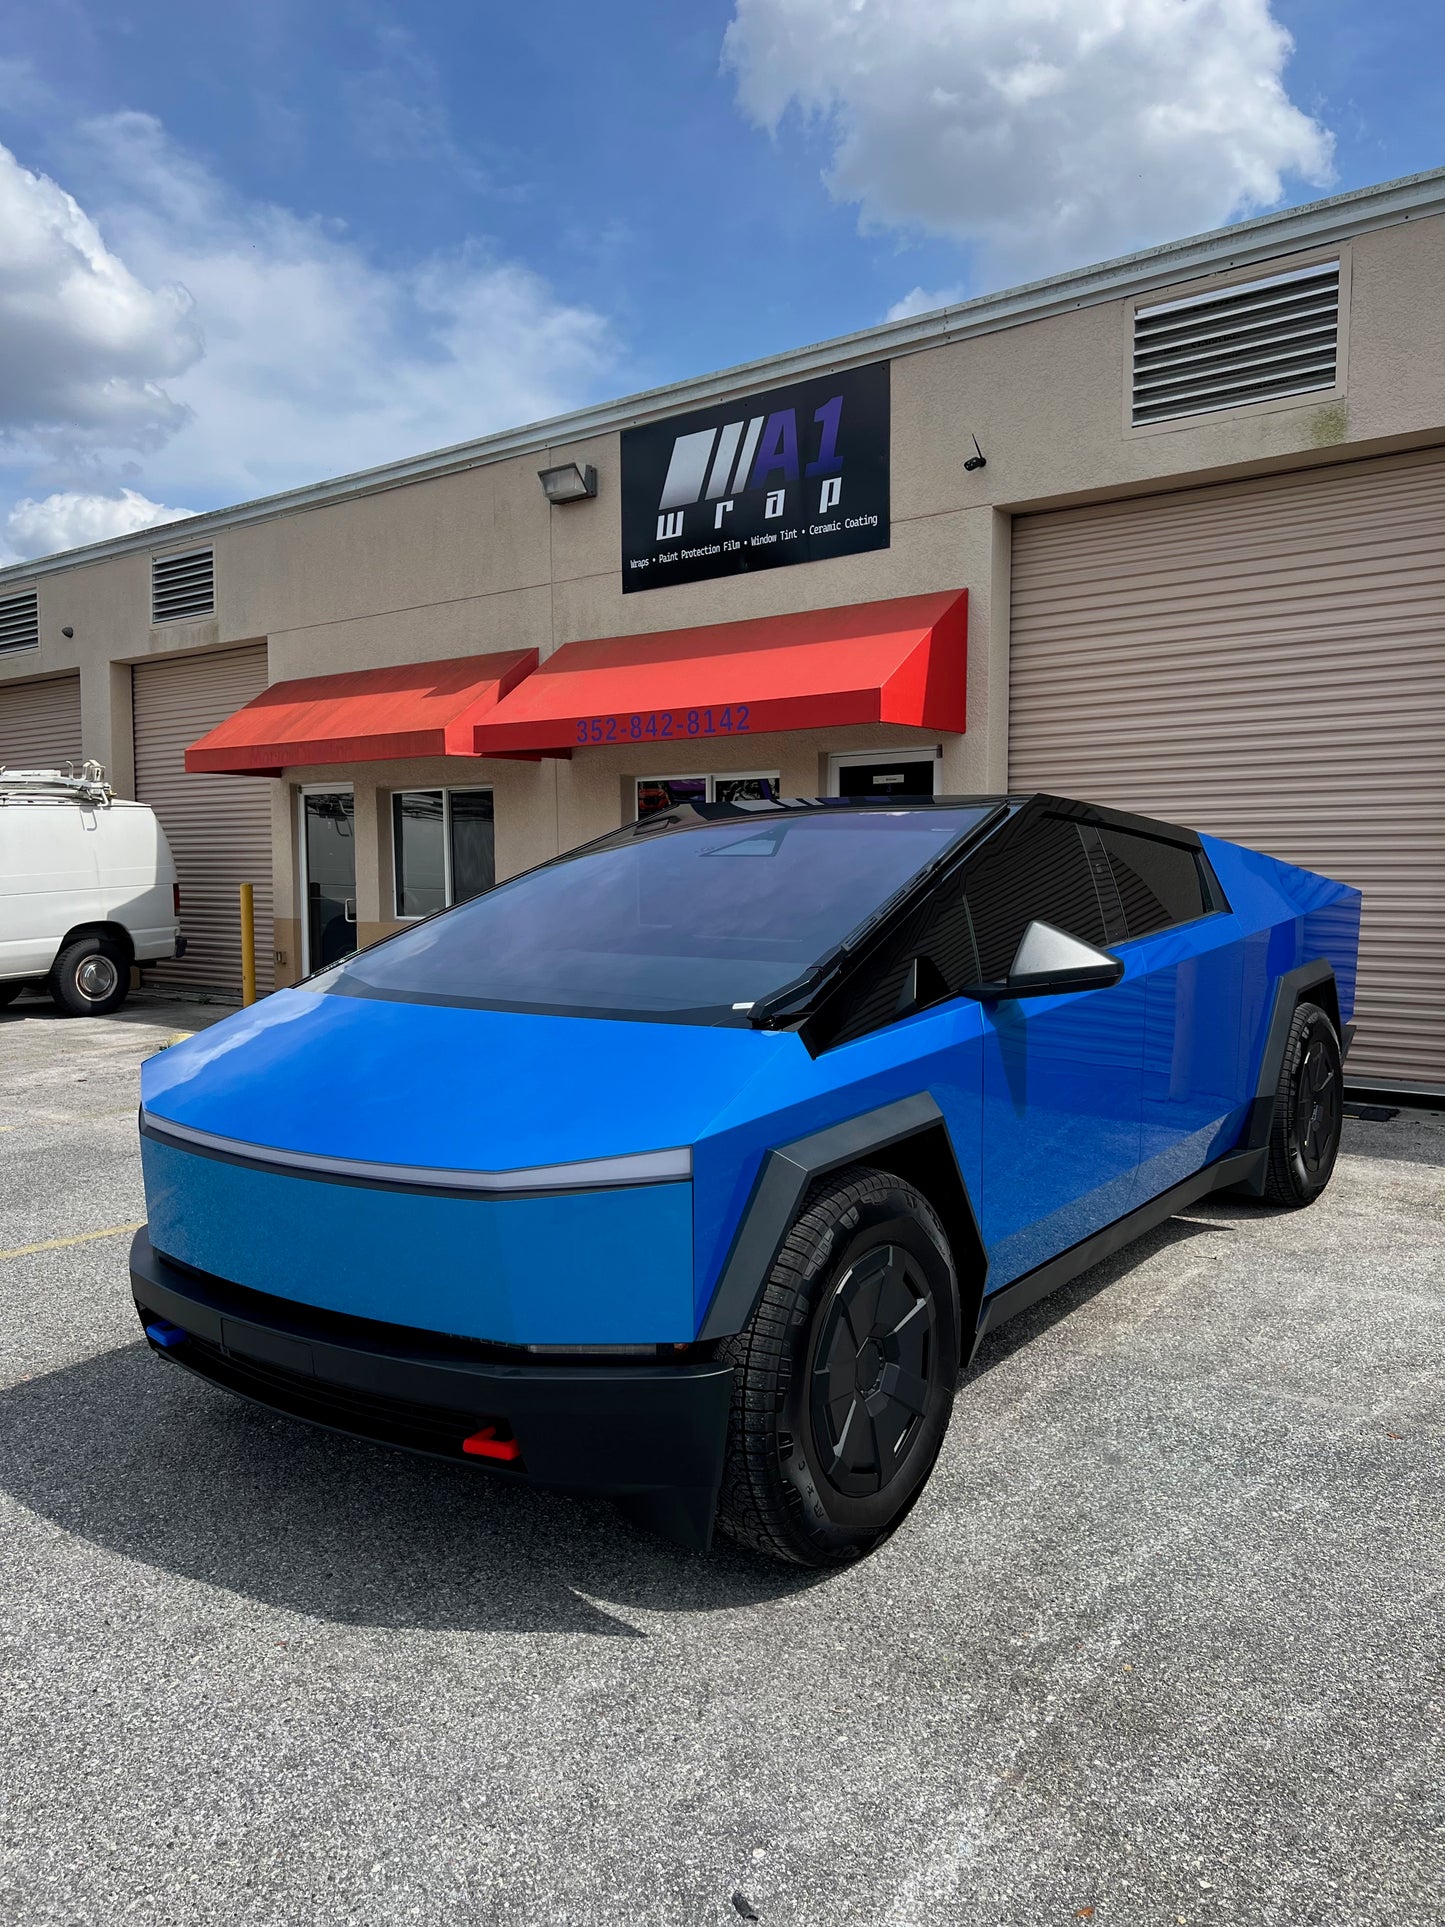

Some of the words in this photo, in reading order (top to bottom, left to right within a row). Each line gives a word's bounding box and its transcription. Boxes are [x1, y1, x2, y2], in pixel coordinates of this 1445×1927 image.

[749, 396, 843, 490] A1
[630, 558, 650, 569] Wraps
[659, 551, 679, 564] Paint
[681, 544, 720, 559] Protection
[723, 540, 741, 551] Film
[751, 533, 777, 546] Window
[780, 528, 798, 540] Tint
[809, 520, 841, 535] Ceramic
[844, 514, 878, 529] Coating
[576, 705, 750, 743] 352-842-8142
